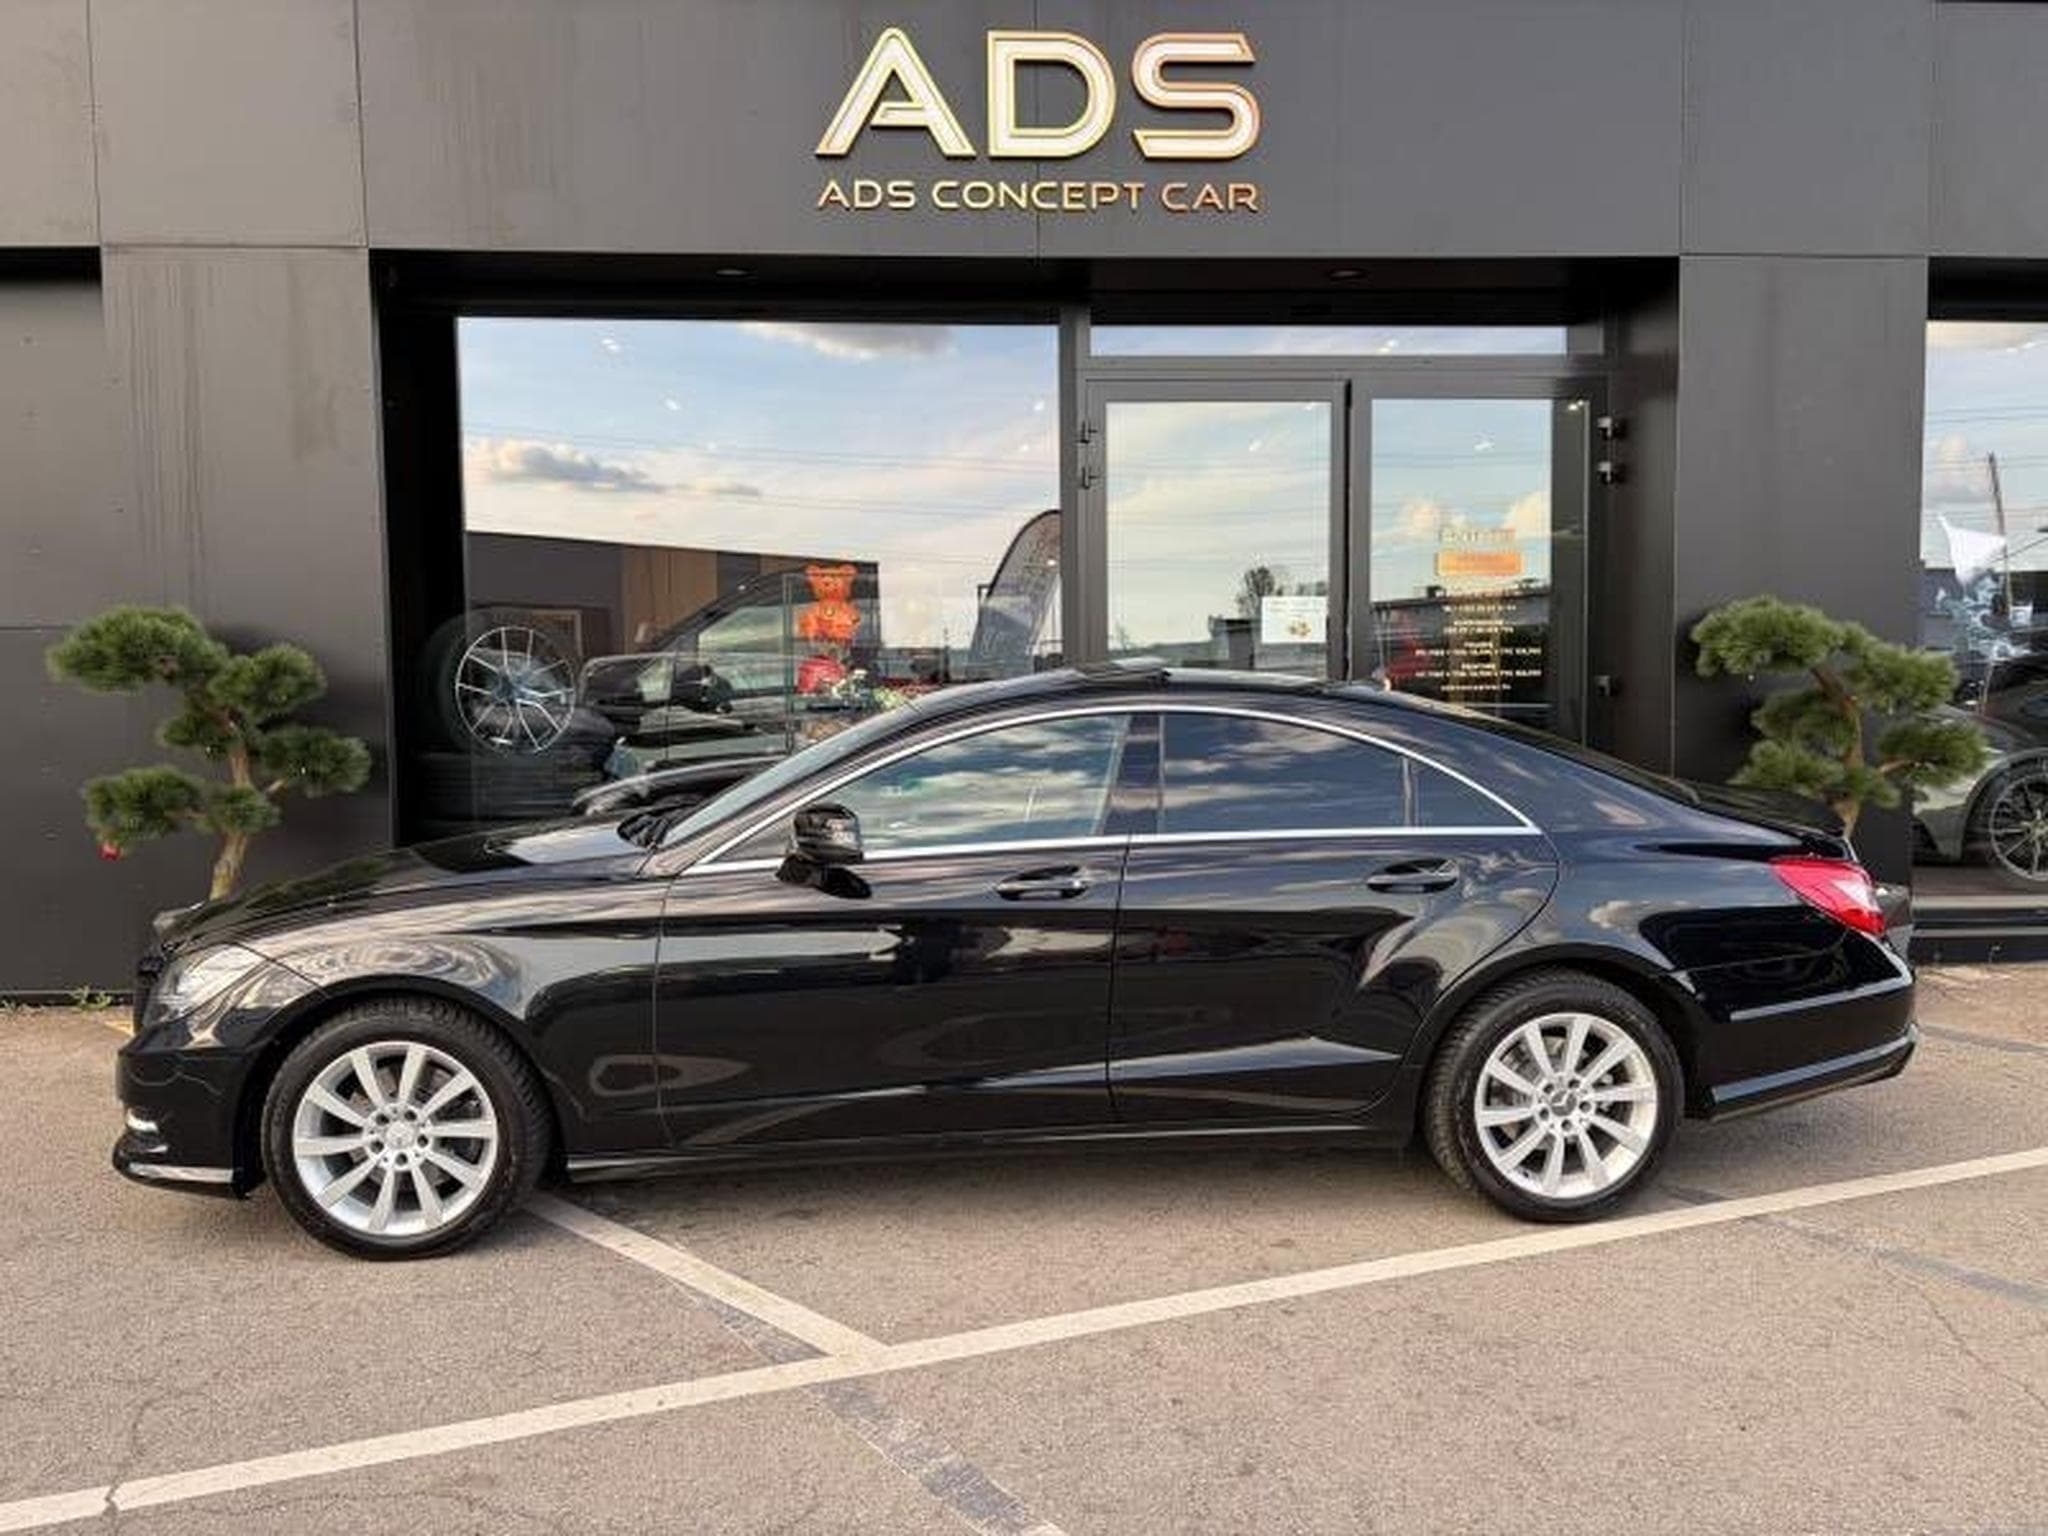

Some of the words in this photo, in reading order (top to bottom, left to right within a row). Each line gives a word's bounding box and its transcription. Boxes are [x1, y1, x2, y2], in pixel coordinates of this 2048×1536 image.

[814, 27, 1261, 160] ADS
[816, 180, 916, 211] ADS
[932, 181, 1146, 212] CONCEPT
[1162, 182, 1259, 212] CAR
